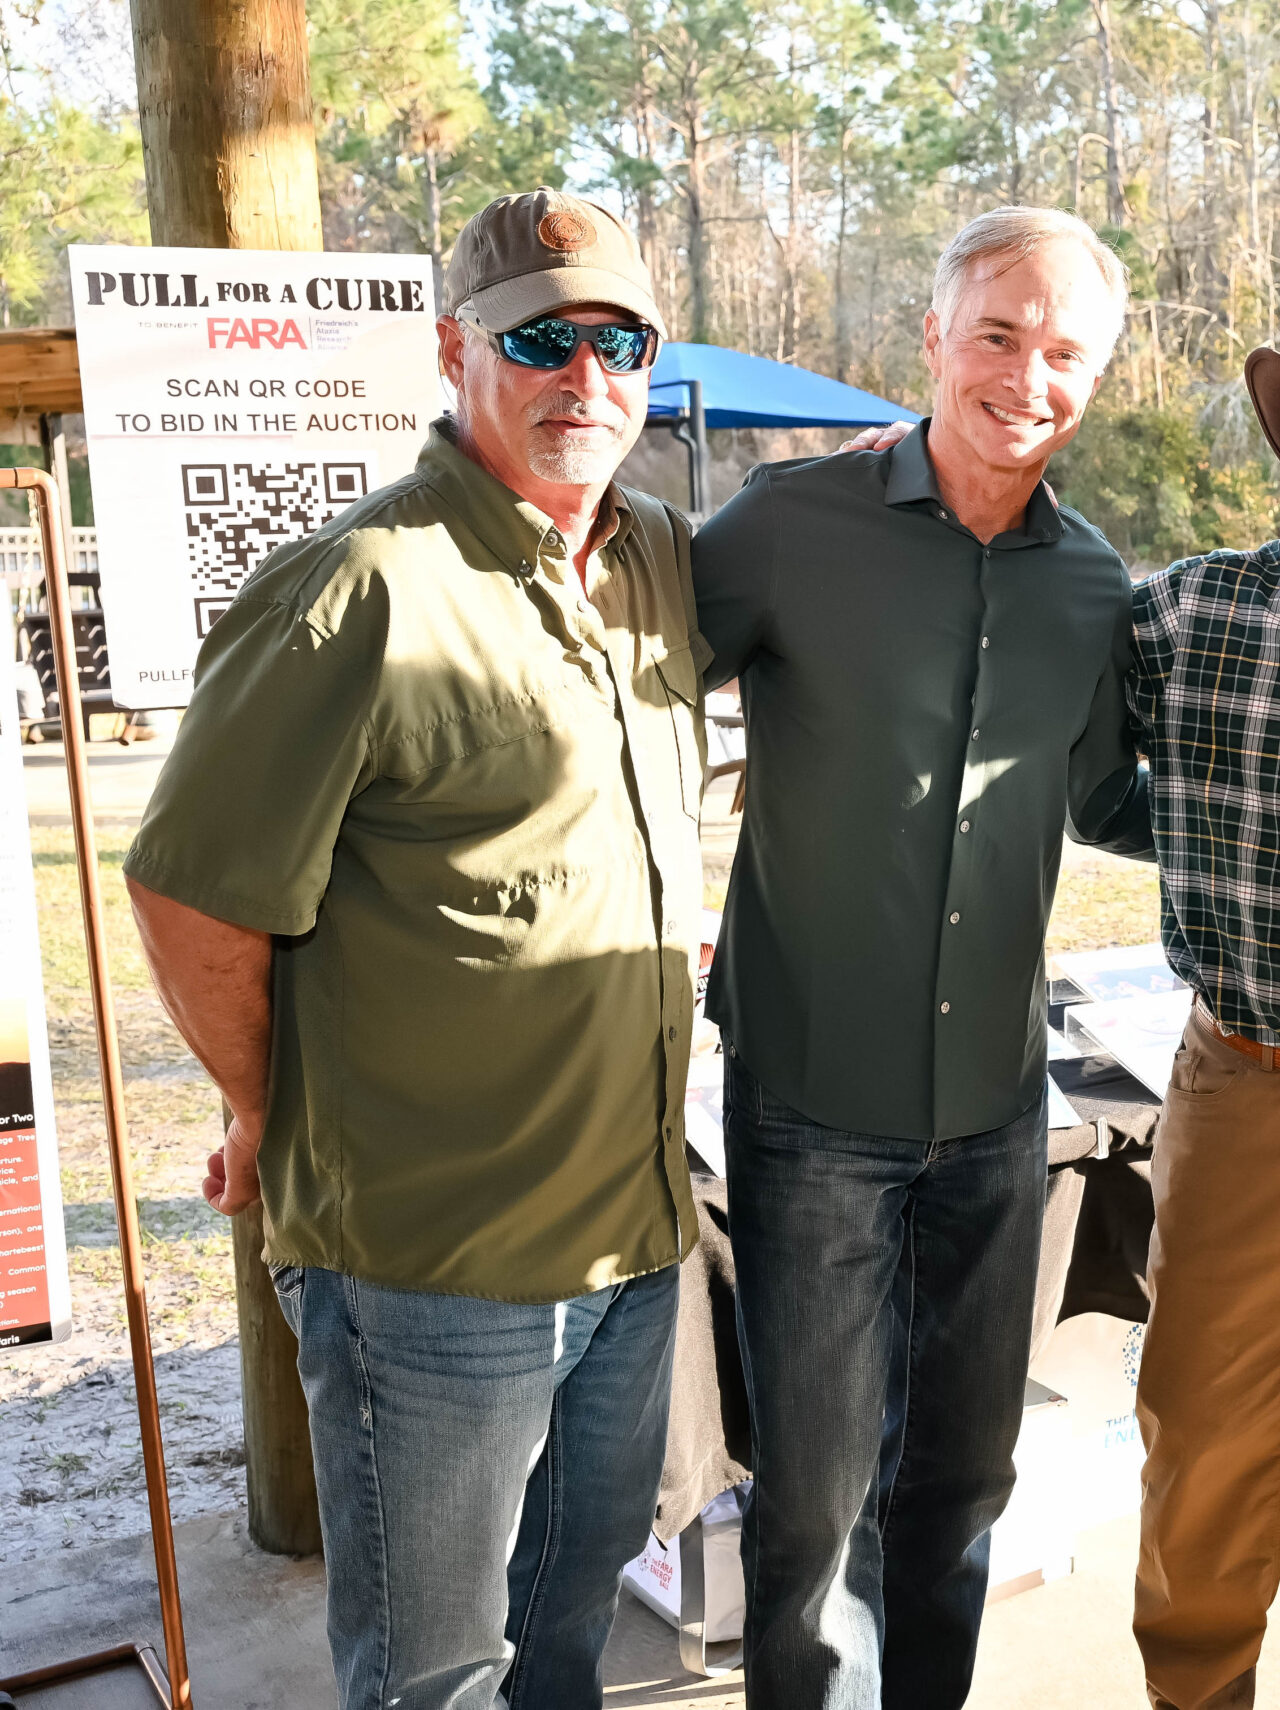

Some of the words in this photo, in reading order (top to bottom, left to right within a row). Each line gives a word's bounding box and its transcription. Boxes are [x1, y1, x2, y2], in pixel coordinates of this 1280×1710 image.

[85, 271, 209, 307] PULL
[216, 282, 271, 303] FOR
[280, 283, 297, 303] A
[305, 277, 425, 312] CURE
[206, 317, 308, 350] FARA
[167, 379, 239, 398] SCAN
[249, 379, 286, 398] QR
[295, 380, 366, 398] CODE
[115, 413, 151, 432] TO
[160, 414, 204, 432] BID
[214, 414, 239, 431] IN
[247, 414, 298, 432] THE
[306, 413, 417, 432] AUCTION
[12, 1113, 34, 1123] Two
[8, 1264, 46, 1276] Common
[7, 1286, 36, 1296] season
